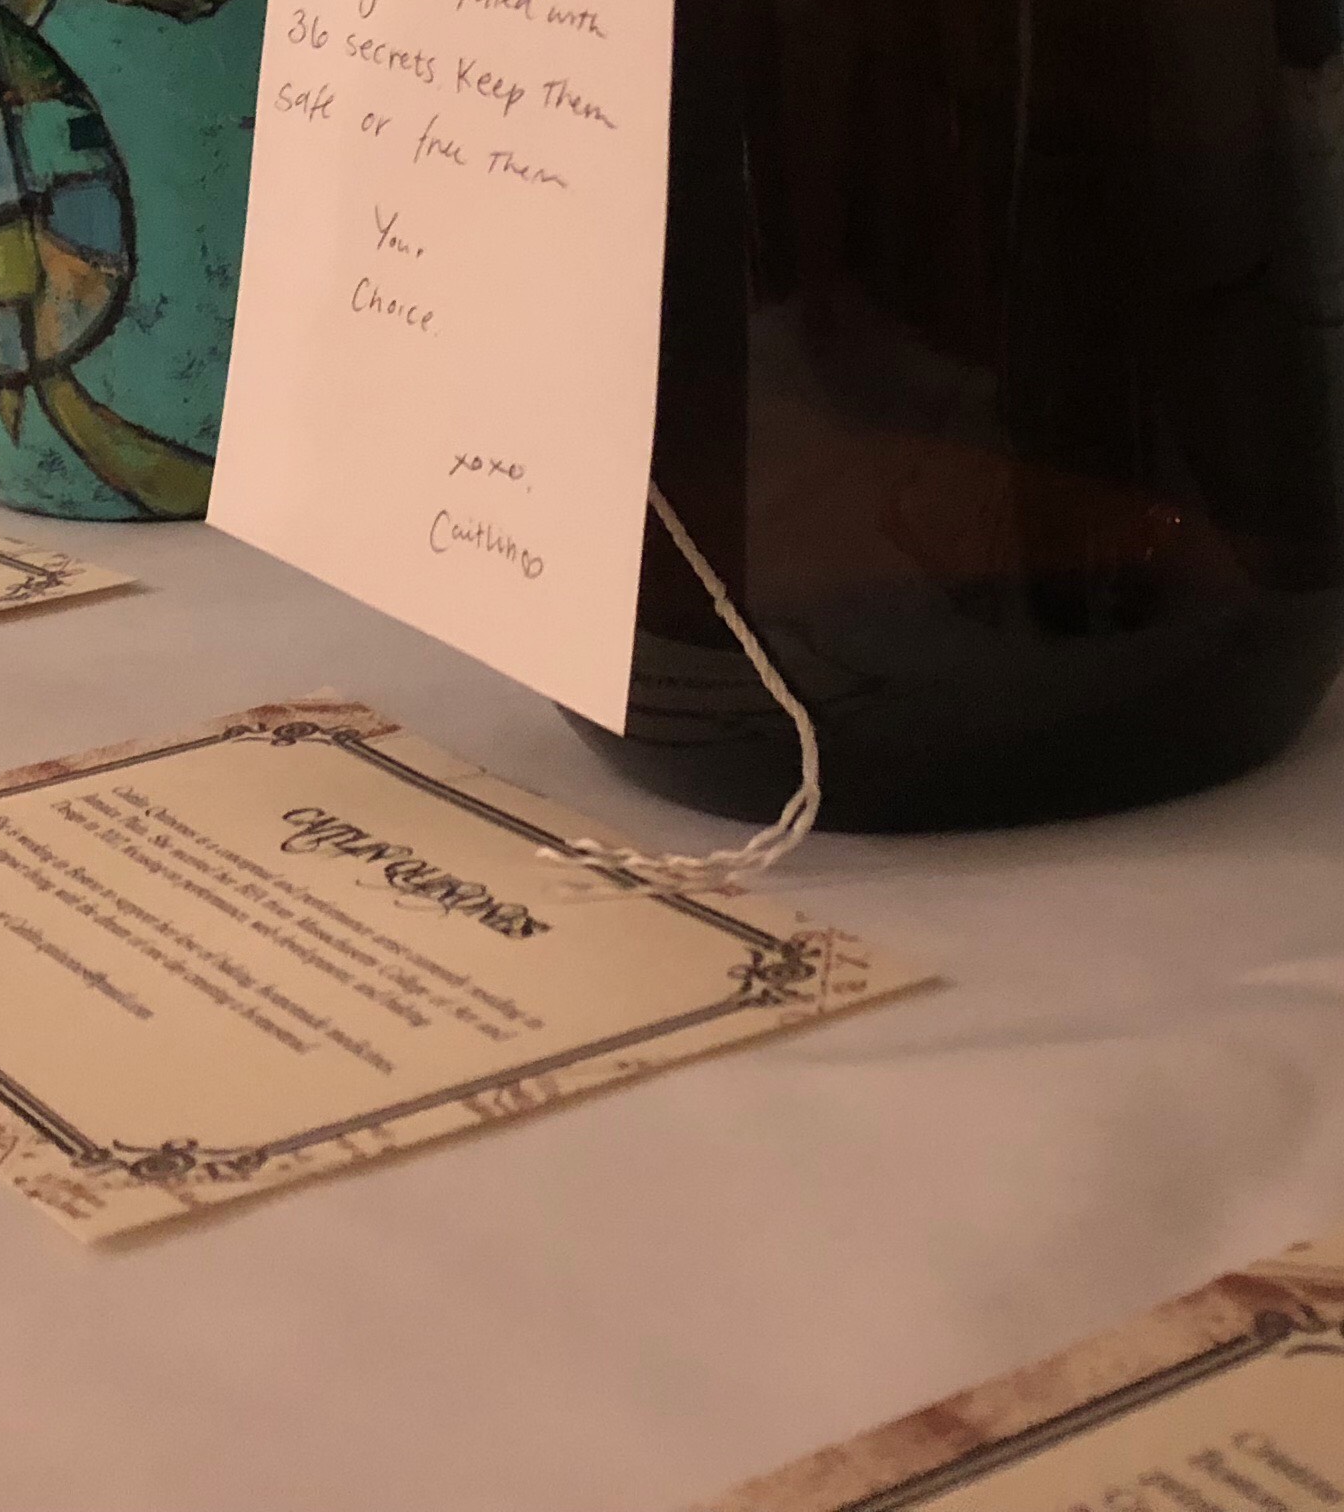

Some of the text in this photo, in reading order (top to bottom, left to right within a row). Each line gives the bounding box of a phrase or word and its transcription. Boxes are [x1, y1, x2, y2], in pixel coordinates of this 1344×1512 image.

[288, 9, 329, 48] 36
[548, 5, 607, 39] with
[362, 113, 391, 136] or
[414, 114, 466, 165] free
